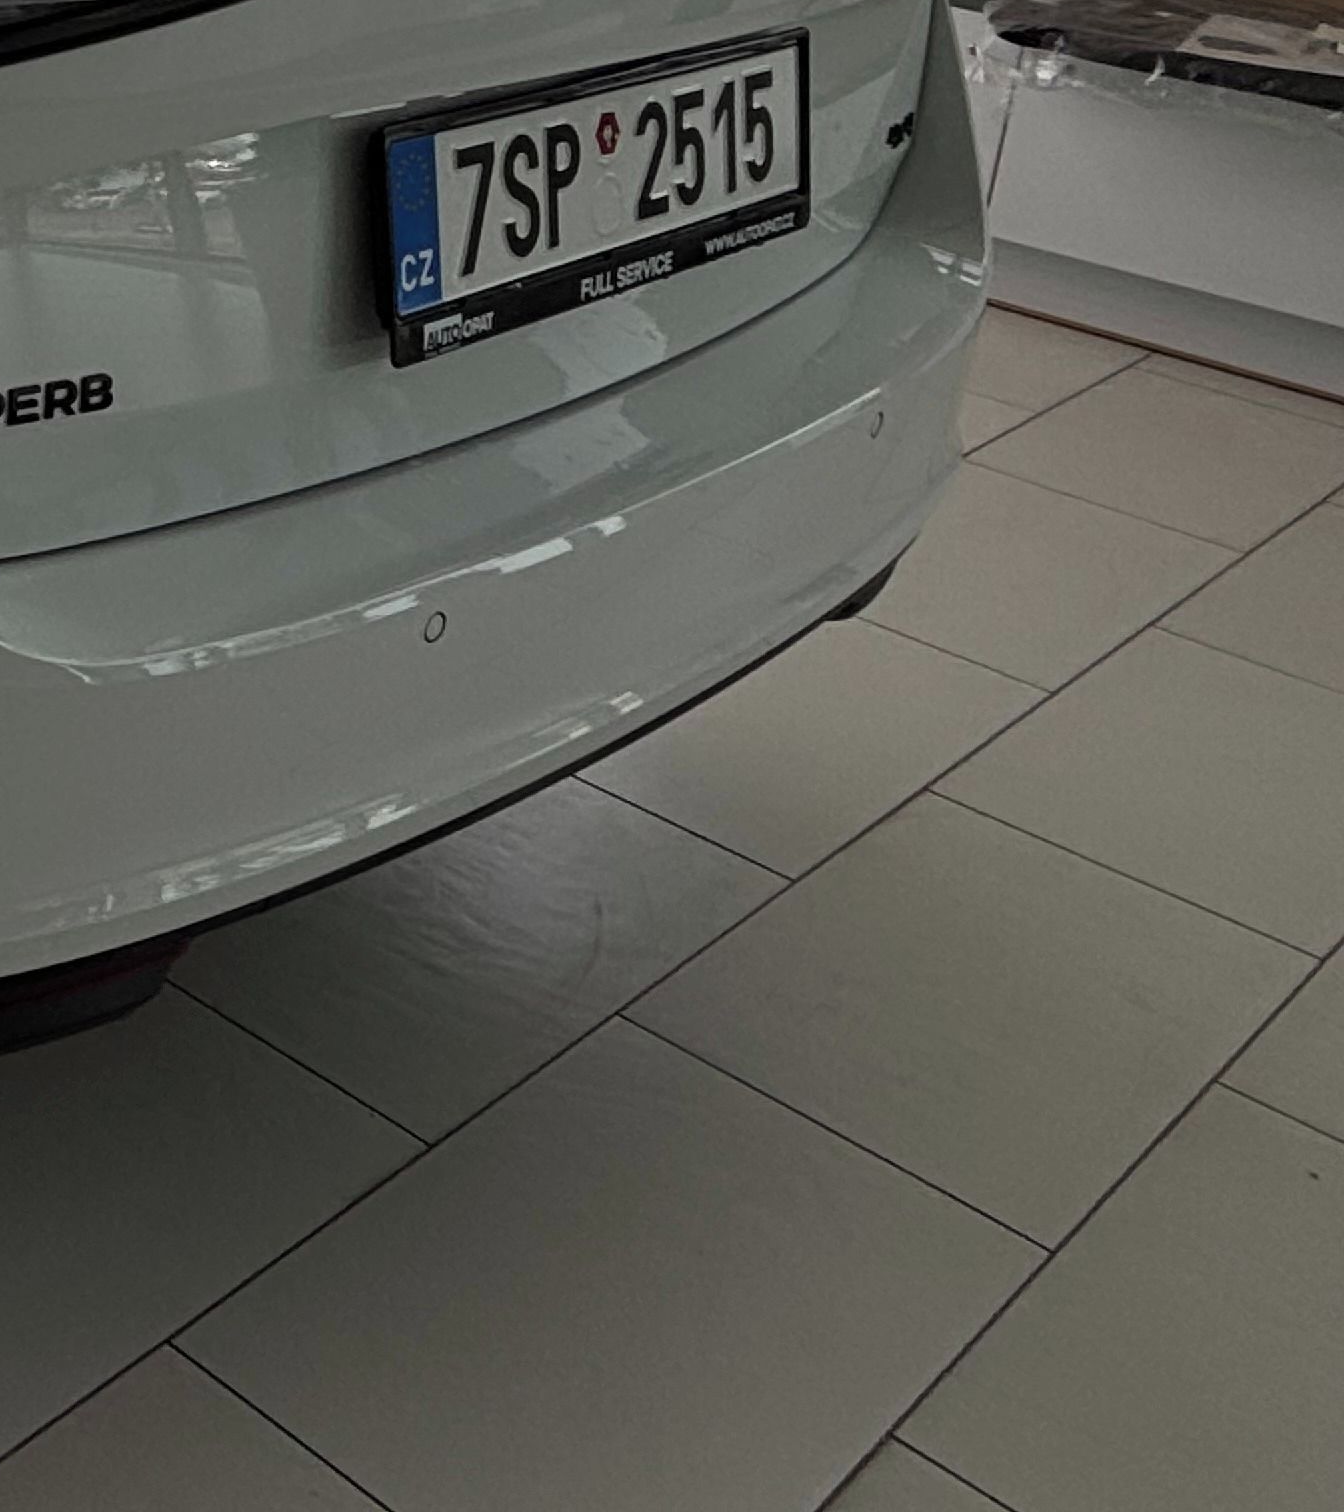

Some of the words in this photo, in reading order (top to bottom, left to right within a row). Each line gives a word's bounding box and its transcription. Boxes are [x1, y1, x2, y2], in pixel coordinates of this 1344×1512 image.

[454, 122, 582, 278] 7SP
[633, 69, 775, 221] 2515
[400, 248, 435, 292] CZ
[580, 270, 614, 302] FULL
[616, 249, 675, 289] SERVICE
